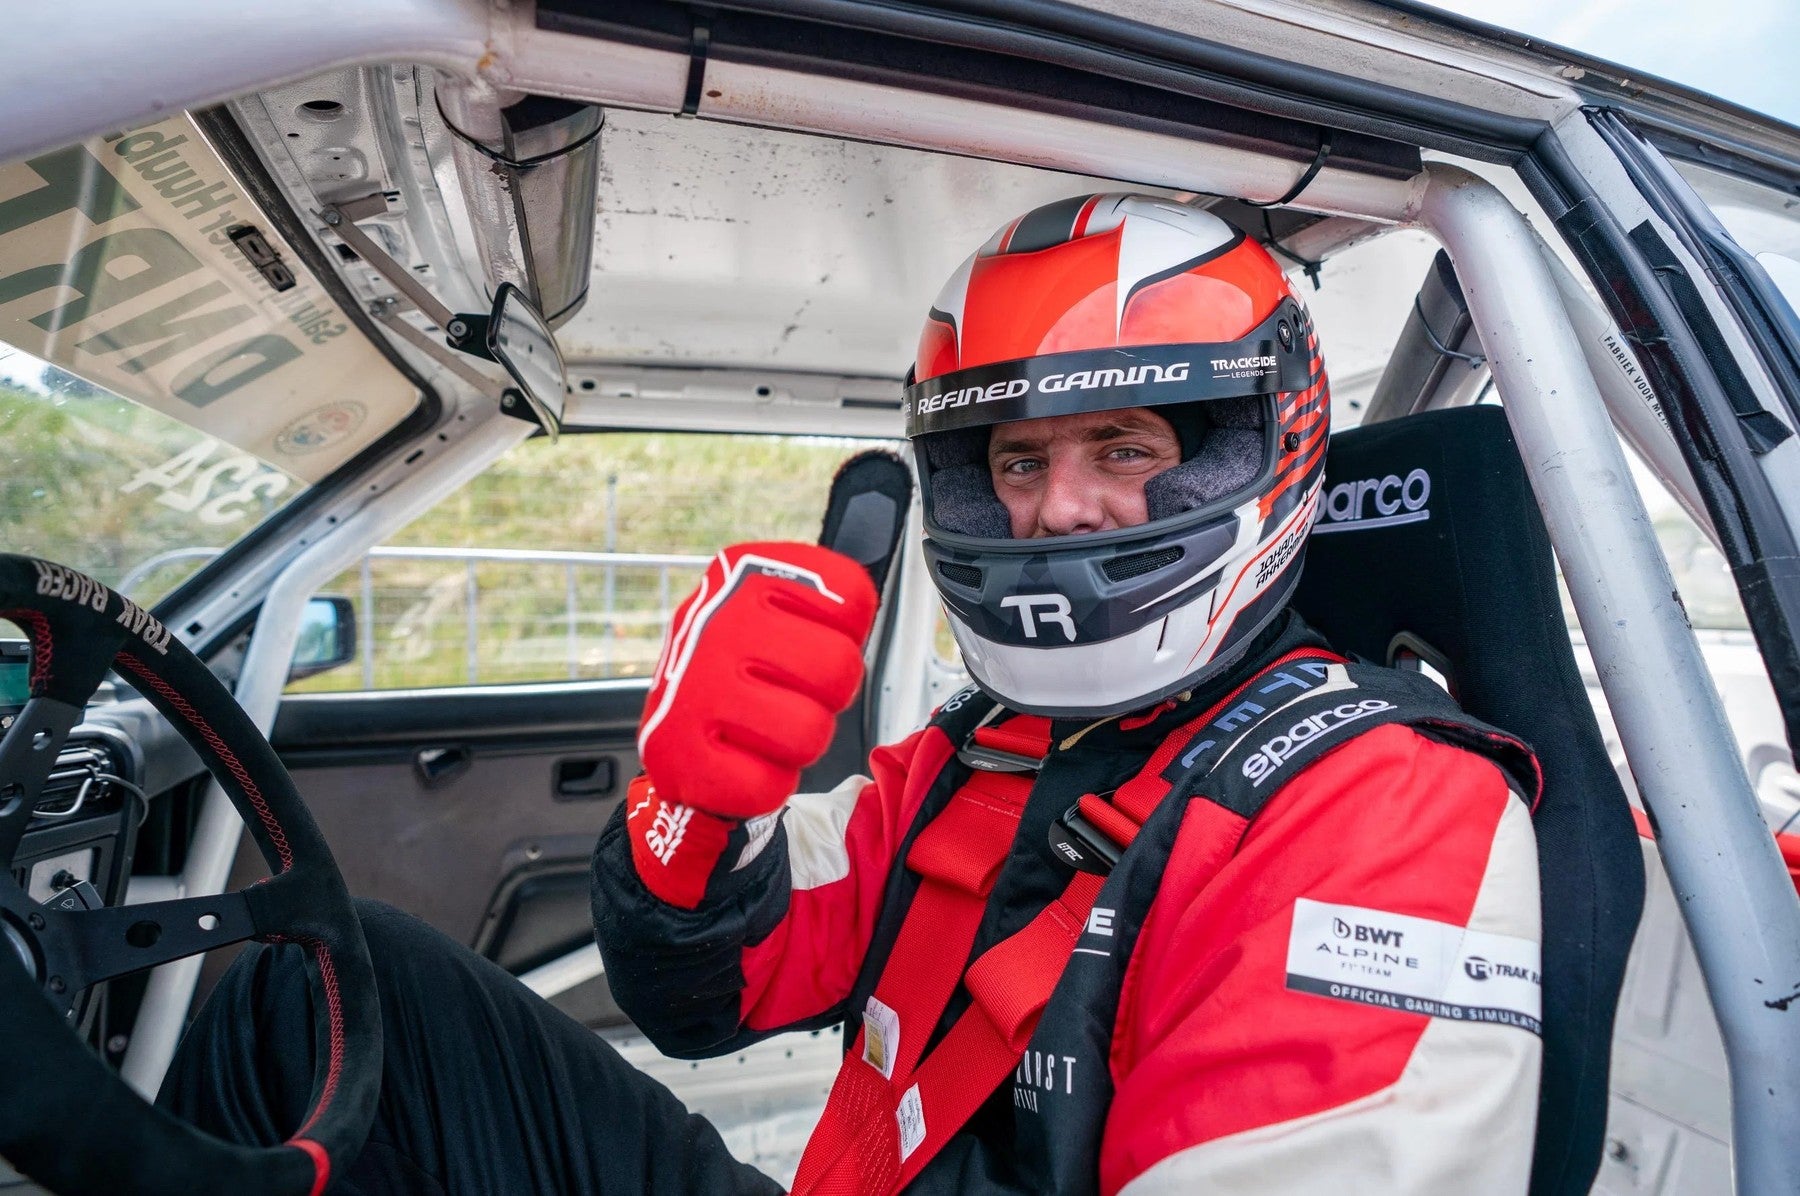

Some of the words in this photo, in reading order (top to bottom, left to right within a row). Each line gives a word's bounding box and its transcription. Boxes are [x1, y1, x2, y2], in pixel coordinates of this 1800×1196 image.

[1210, 355, 1277, 371] TRACKSIDE
[1231, 369, 1265, 379] LEGENDS
[1604, 335, 1637, 377] FABRIEK
[1633, 375, 1656, 402] VOOR
[917, 379, 1031, 416] REFINED
[1038, 362, 1190, 394] GAMING
[32, 560, 109, 614] RACER
[115, 598, 173, 656] TRAK
[1000, 593, 1077, 642] TR
[1241, 699, 1393, 784] sparco
[1354, 924, 1404, 948] BWT
[1316, 942, 1419, 970] ALPINE
[1361, 964, 1392, 978] TEAM
[1496, 963, 1529, 981] TRAK
[1329, 983, 1400, 1009] OFFICIAL
[1404, 997, 1463, 1020] GAMING
